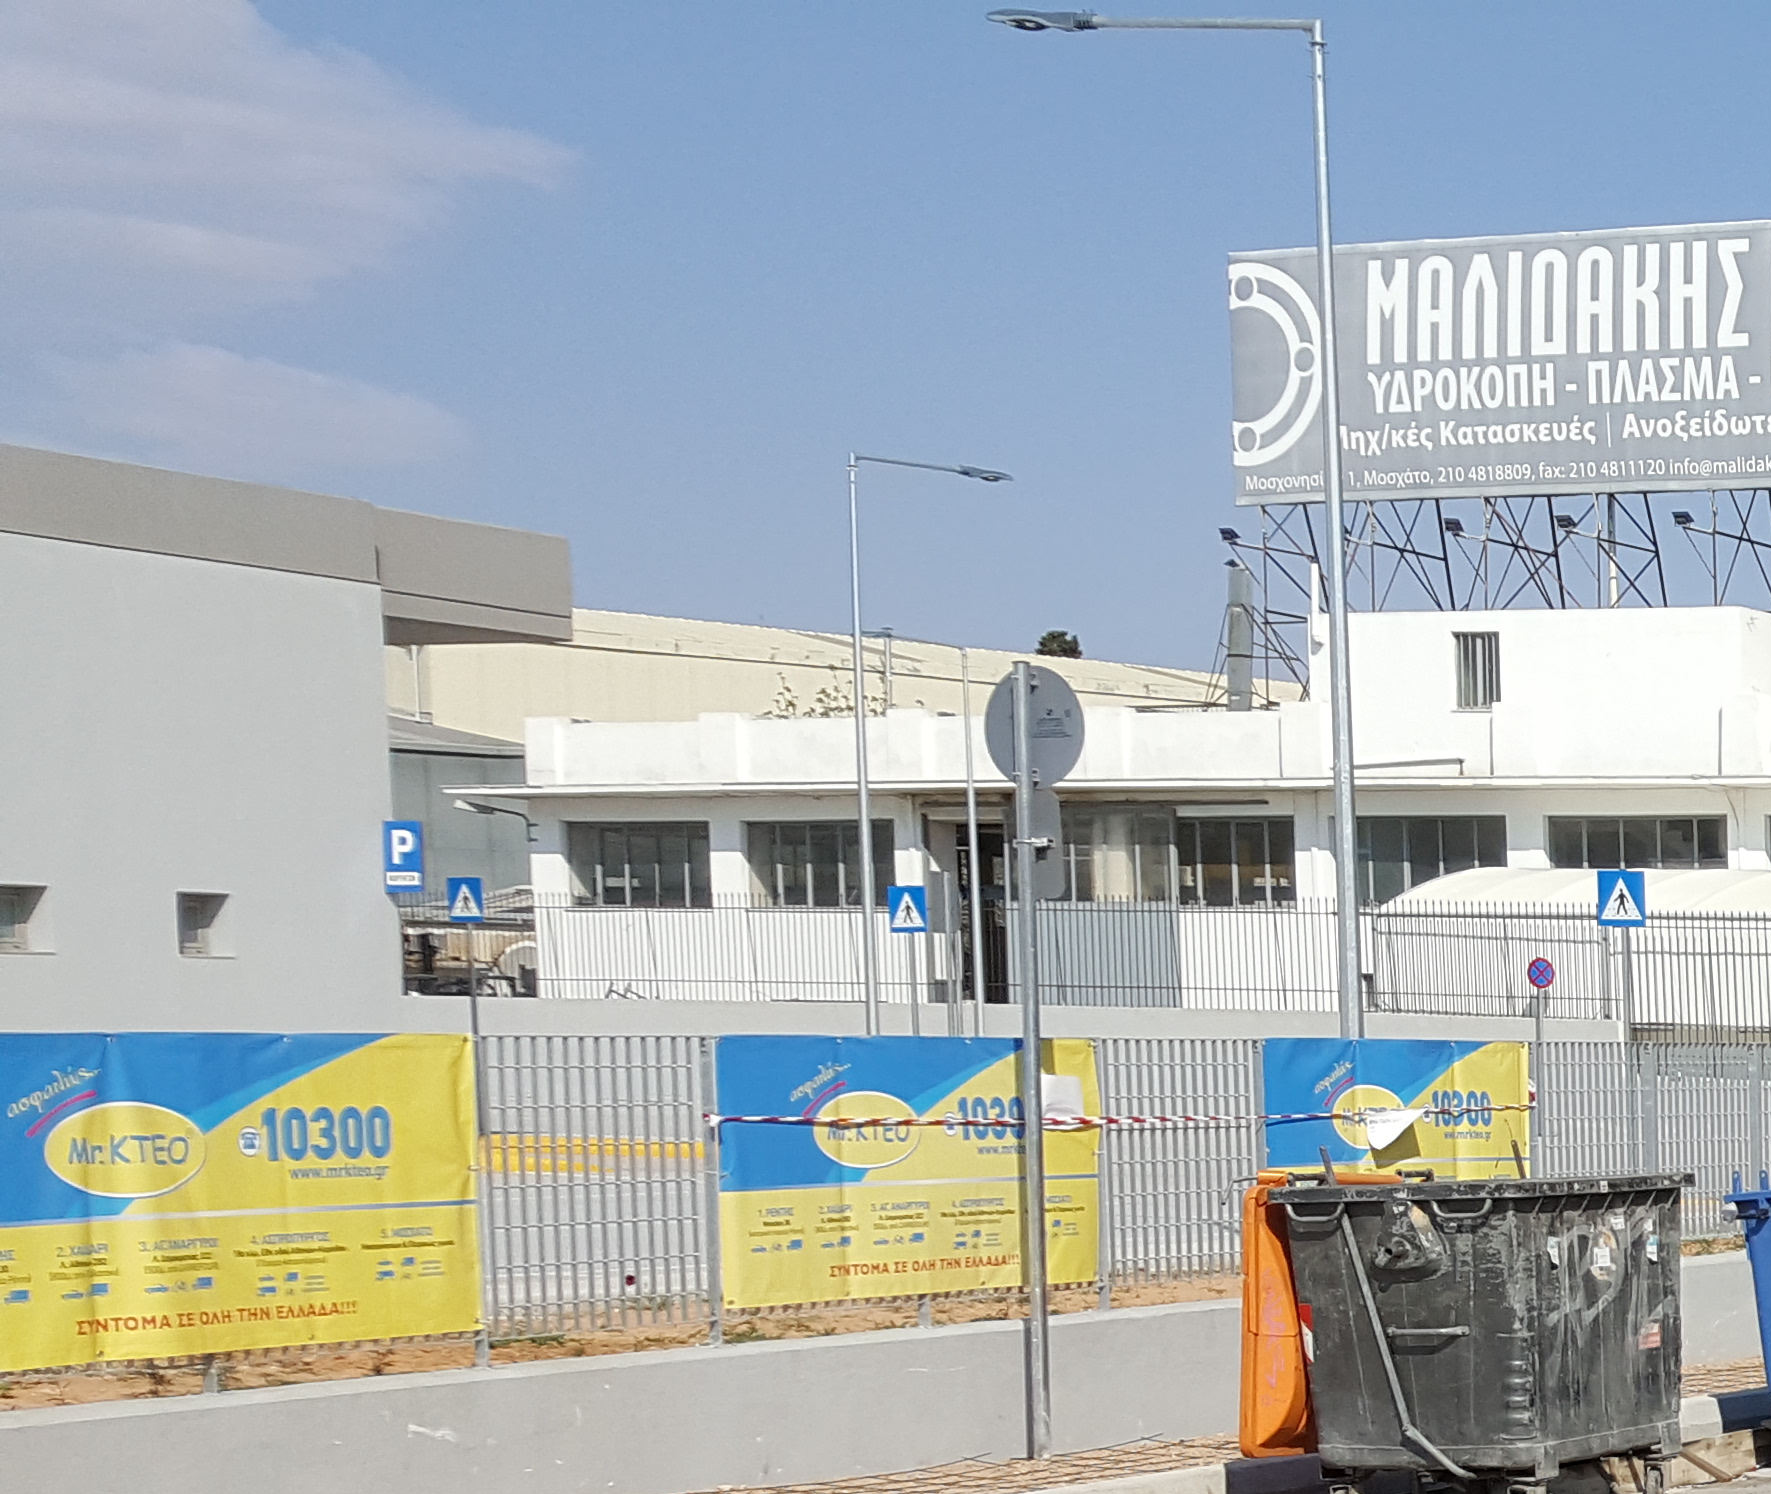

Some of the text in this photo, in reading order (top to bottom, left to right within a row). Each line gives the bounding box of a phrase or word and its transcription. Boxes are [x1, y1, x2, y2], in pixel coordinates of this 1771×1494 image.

[1367, 362, 1555, 414] ΥΔΡΟΚΟΠΗ
[1587, 354, 1740, 404] ΠΛΑΣΜΑ
[1440, 413, 1596, 447] Κατασκευές
[1438, 465, 1464, 483] 210
[1539, 461, 1566, 480] fax:
[1569, 461, 1596, 478] 210
[1600, 459, 1665, 478] 4811120
[391, 829, 413, 864] P
[260, 1106, 392, 1162] 10300
[829, 1262, 890, 1278] ΣΥΝΤΟΜΑ
[893, 1261, 908, 1274] ΣΕ
[912, 1259, 937, 1272] ΟΛΗ
[939, 1257, 962, 1270] ΤΗΝ
[76, 1314, 172, 1336] ΣΥΝΤΟΜΑ
[177, 1312, 196, 1328] ΣΕ
[200, 1309, 232, 1326] ΟΛΗ
[237, 1306, 271, 1323] ΤΗΝ
